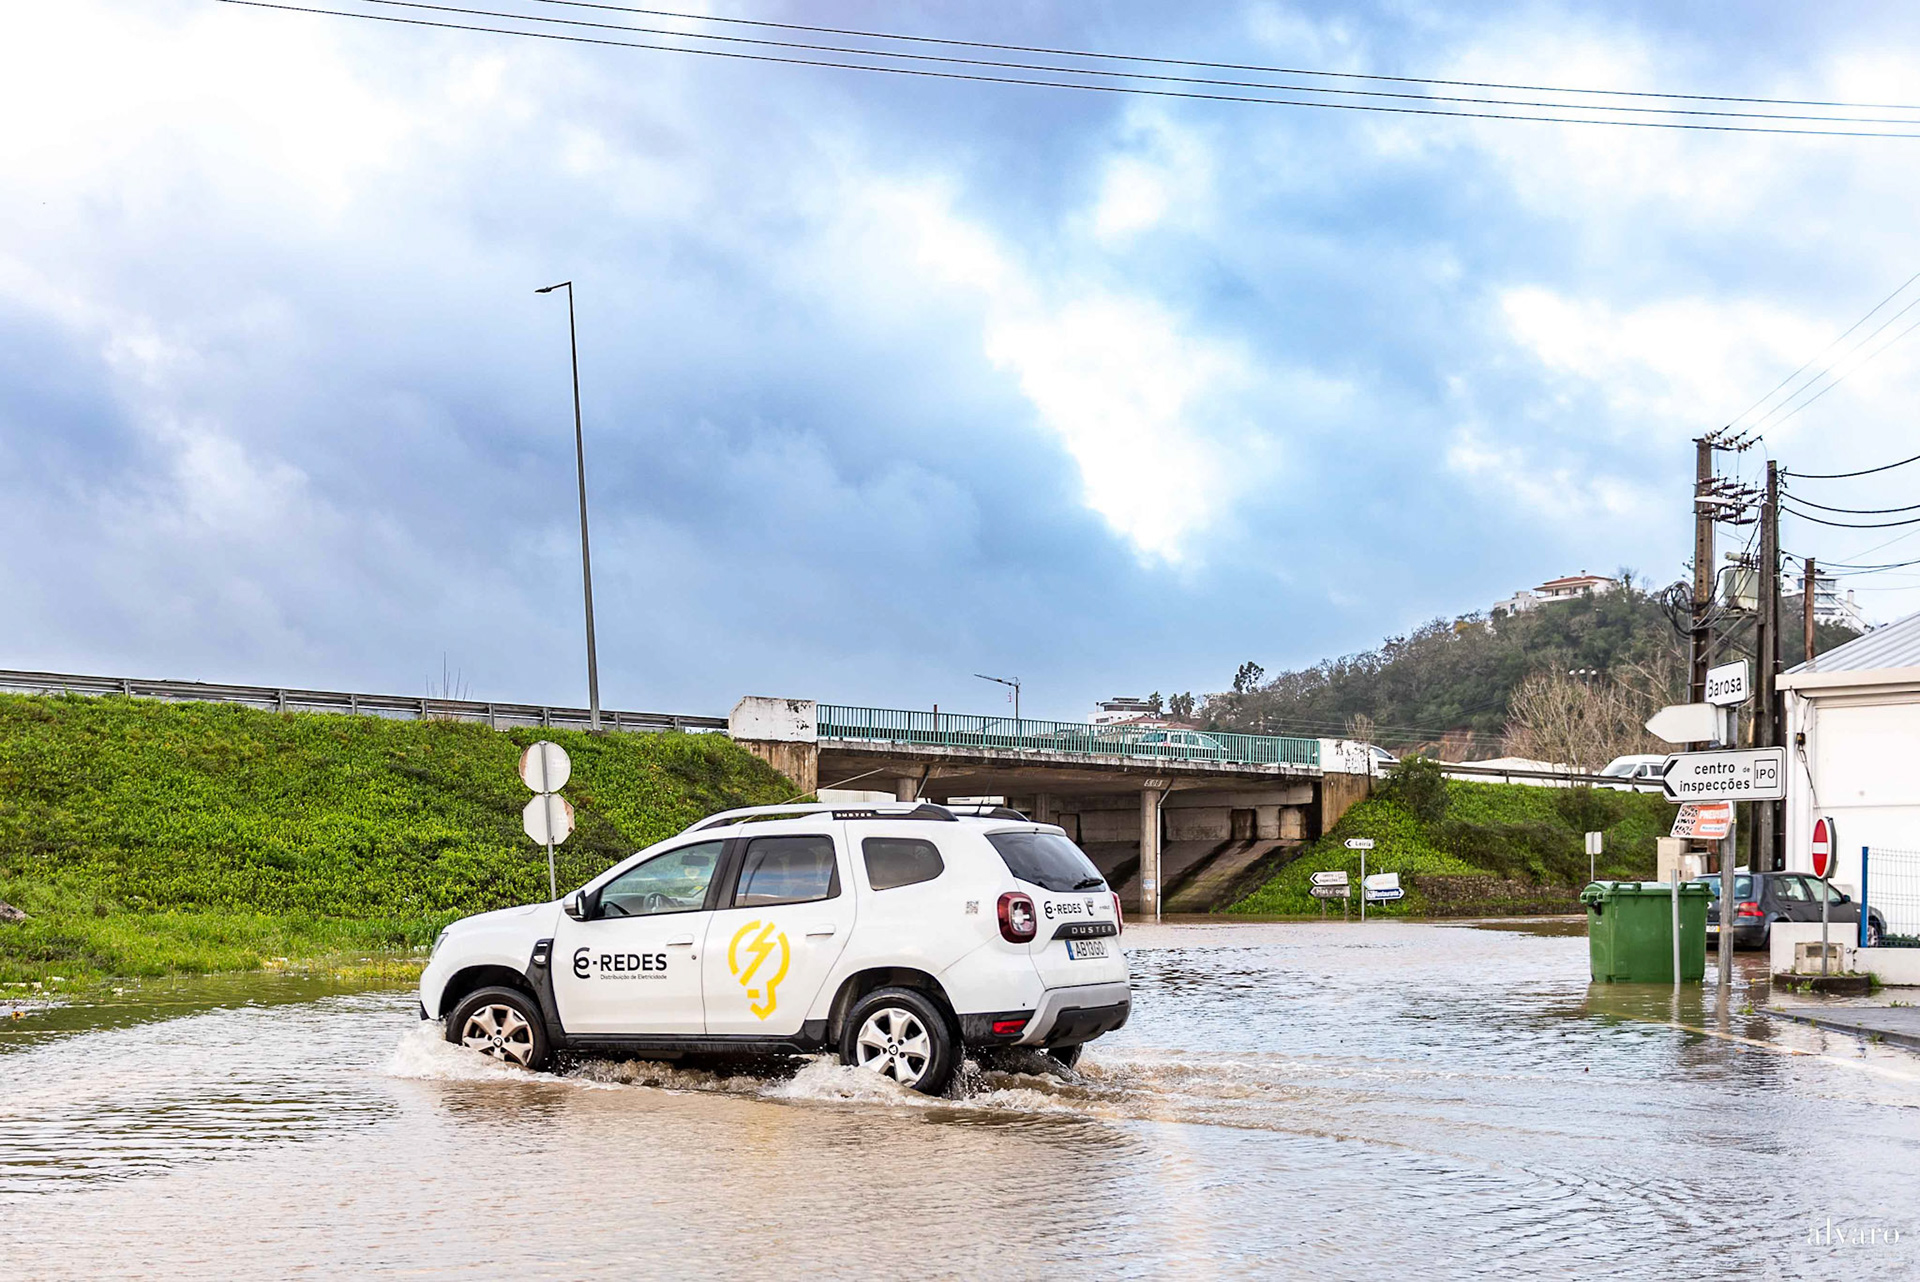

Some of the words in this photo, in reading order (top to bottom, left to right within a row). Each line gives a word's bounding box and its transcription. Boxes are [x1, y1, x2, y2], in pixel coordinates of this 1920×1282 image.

[1708, 677, 1742, 698] Barosa
[1694, 761, 1736, 775] centro
[1756, 768, 1776, 780] IPO
[1679, 777, 1750, 794] inspecções
[1071, 925, 1112, 934] DUSTER
